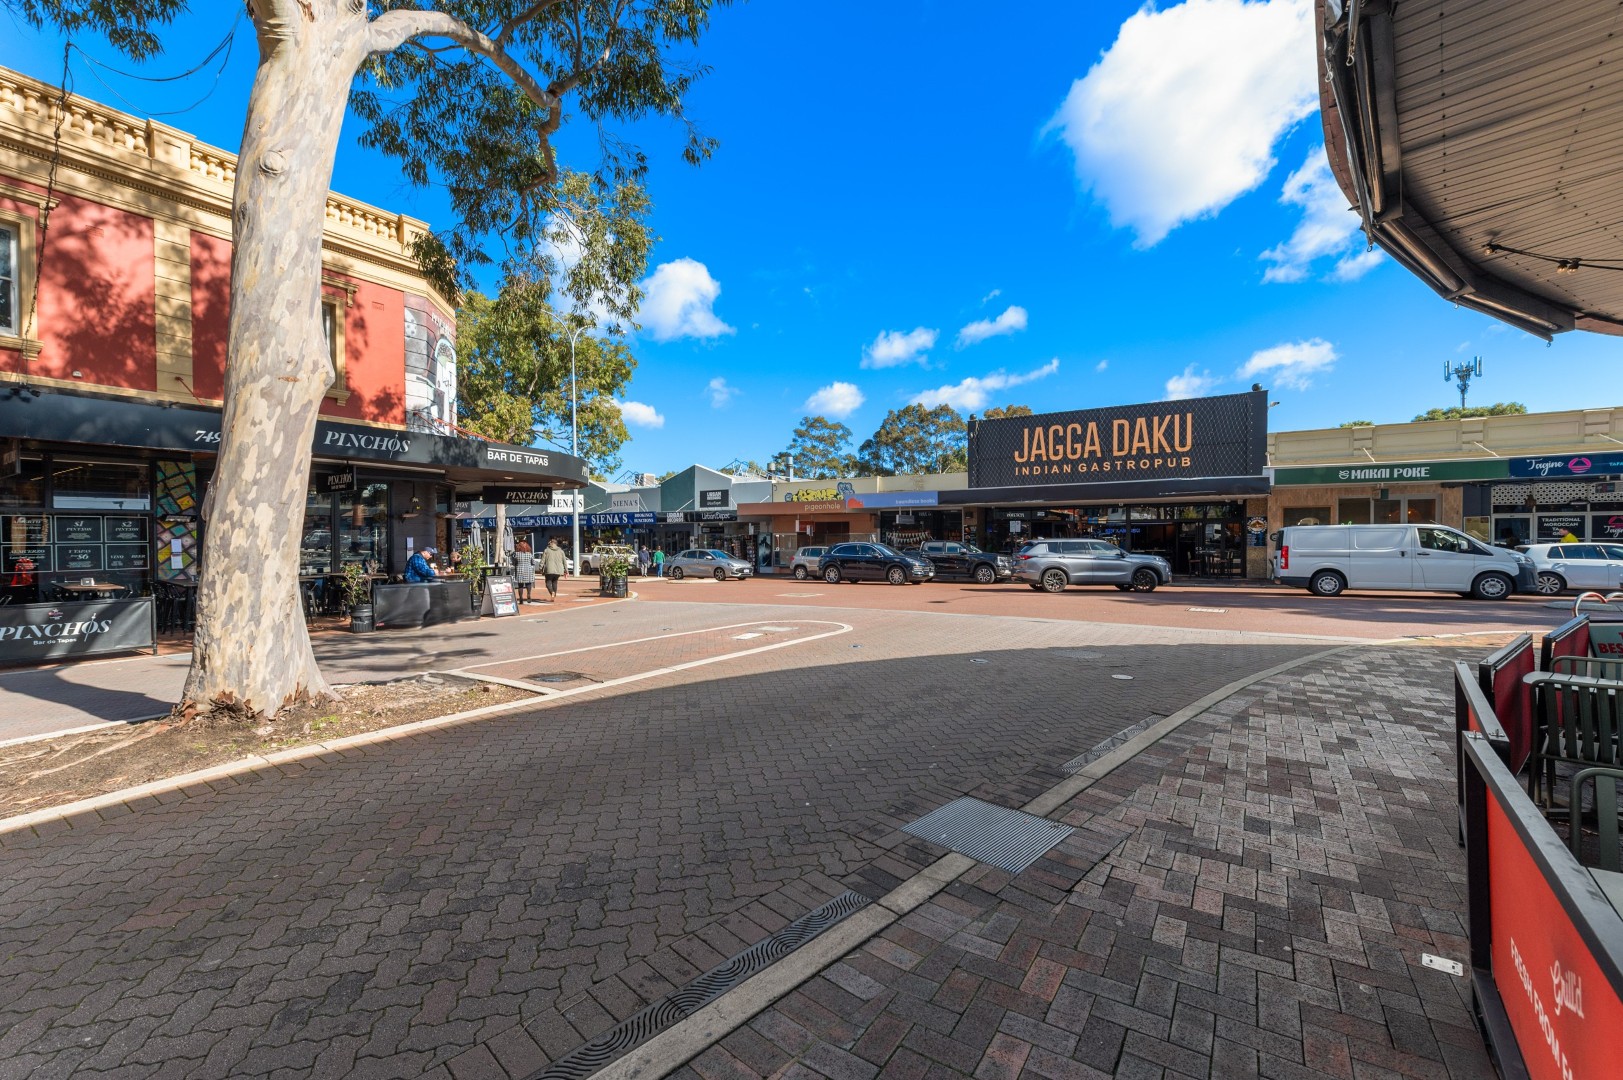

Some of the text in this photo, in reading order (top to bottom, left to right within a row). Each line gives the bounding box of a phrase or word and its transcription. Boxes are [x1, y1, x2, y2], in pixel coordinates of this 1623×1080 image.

[194, 430, 221, 443] 749
[323, 430, 411, 456] PINCHOS
[1014, 412, 1193, 463] JAGGA DAKU
[487, 451, 549, 466] BAR DE TAPAS
[1015, 456, 1191, 476] INDIAN GASTROPUB
[1351, 466, 1430, 479] MAKAI POKE
[1526, 458, 1564, 476] Tagine
[328, 473, 353, 486] PINCHOS
[506, 491, 549, 500] PINCHOS
[613, 499, 638, 507] SIENA'S
[804, 502, 841, 511] pigeonhole
[536, 515, 568, 526] SIENA'S
[591, 513, 628, 524] SIENA'S
[0, 616, 112, 641] PINCHOS
[1510, 936, 1533, 1004] FRESH
[1534, 989, 1560, 1068] FROM
